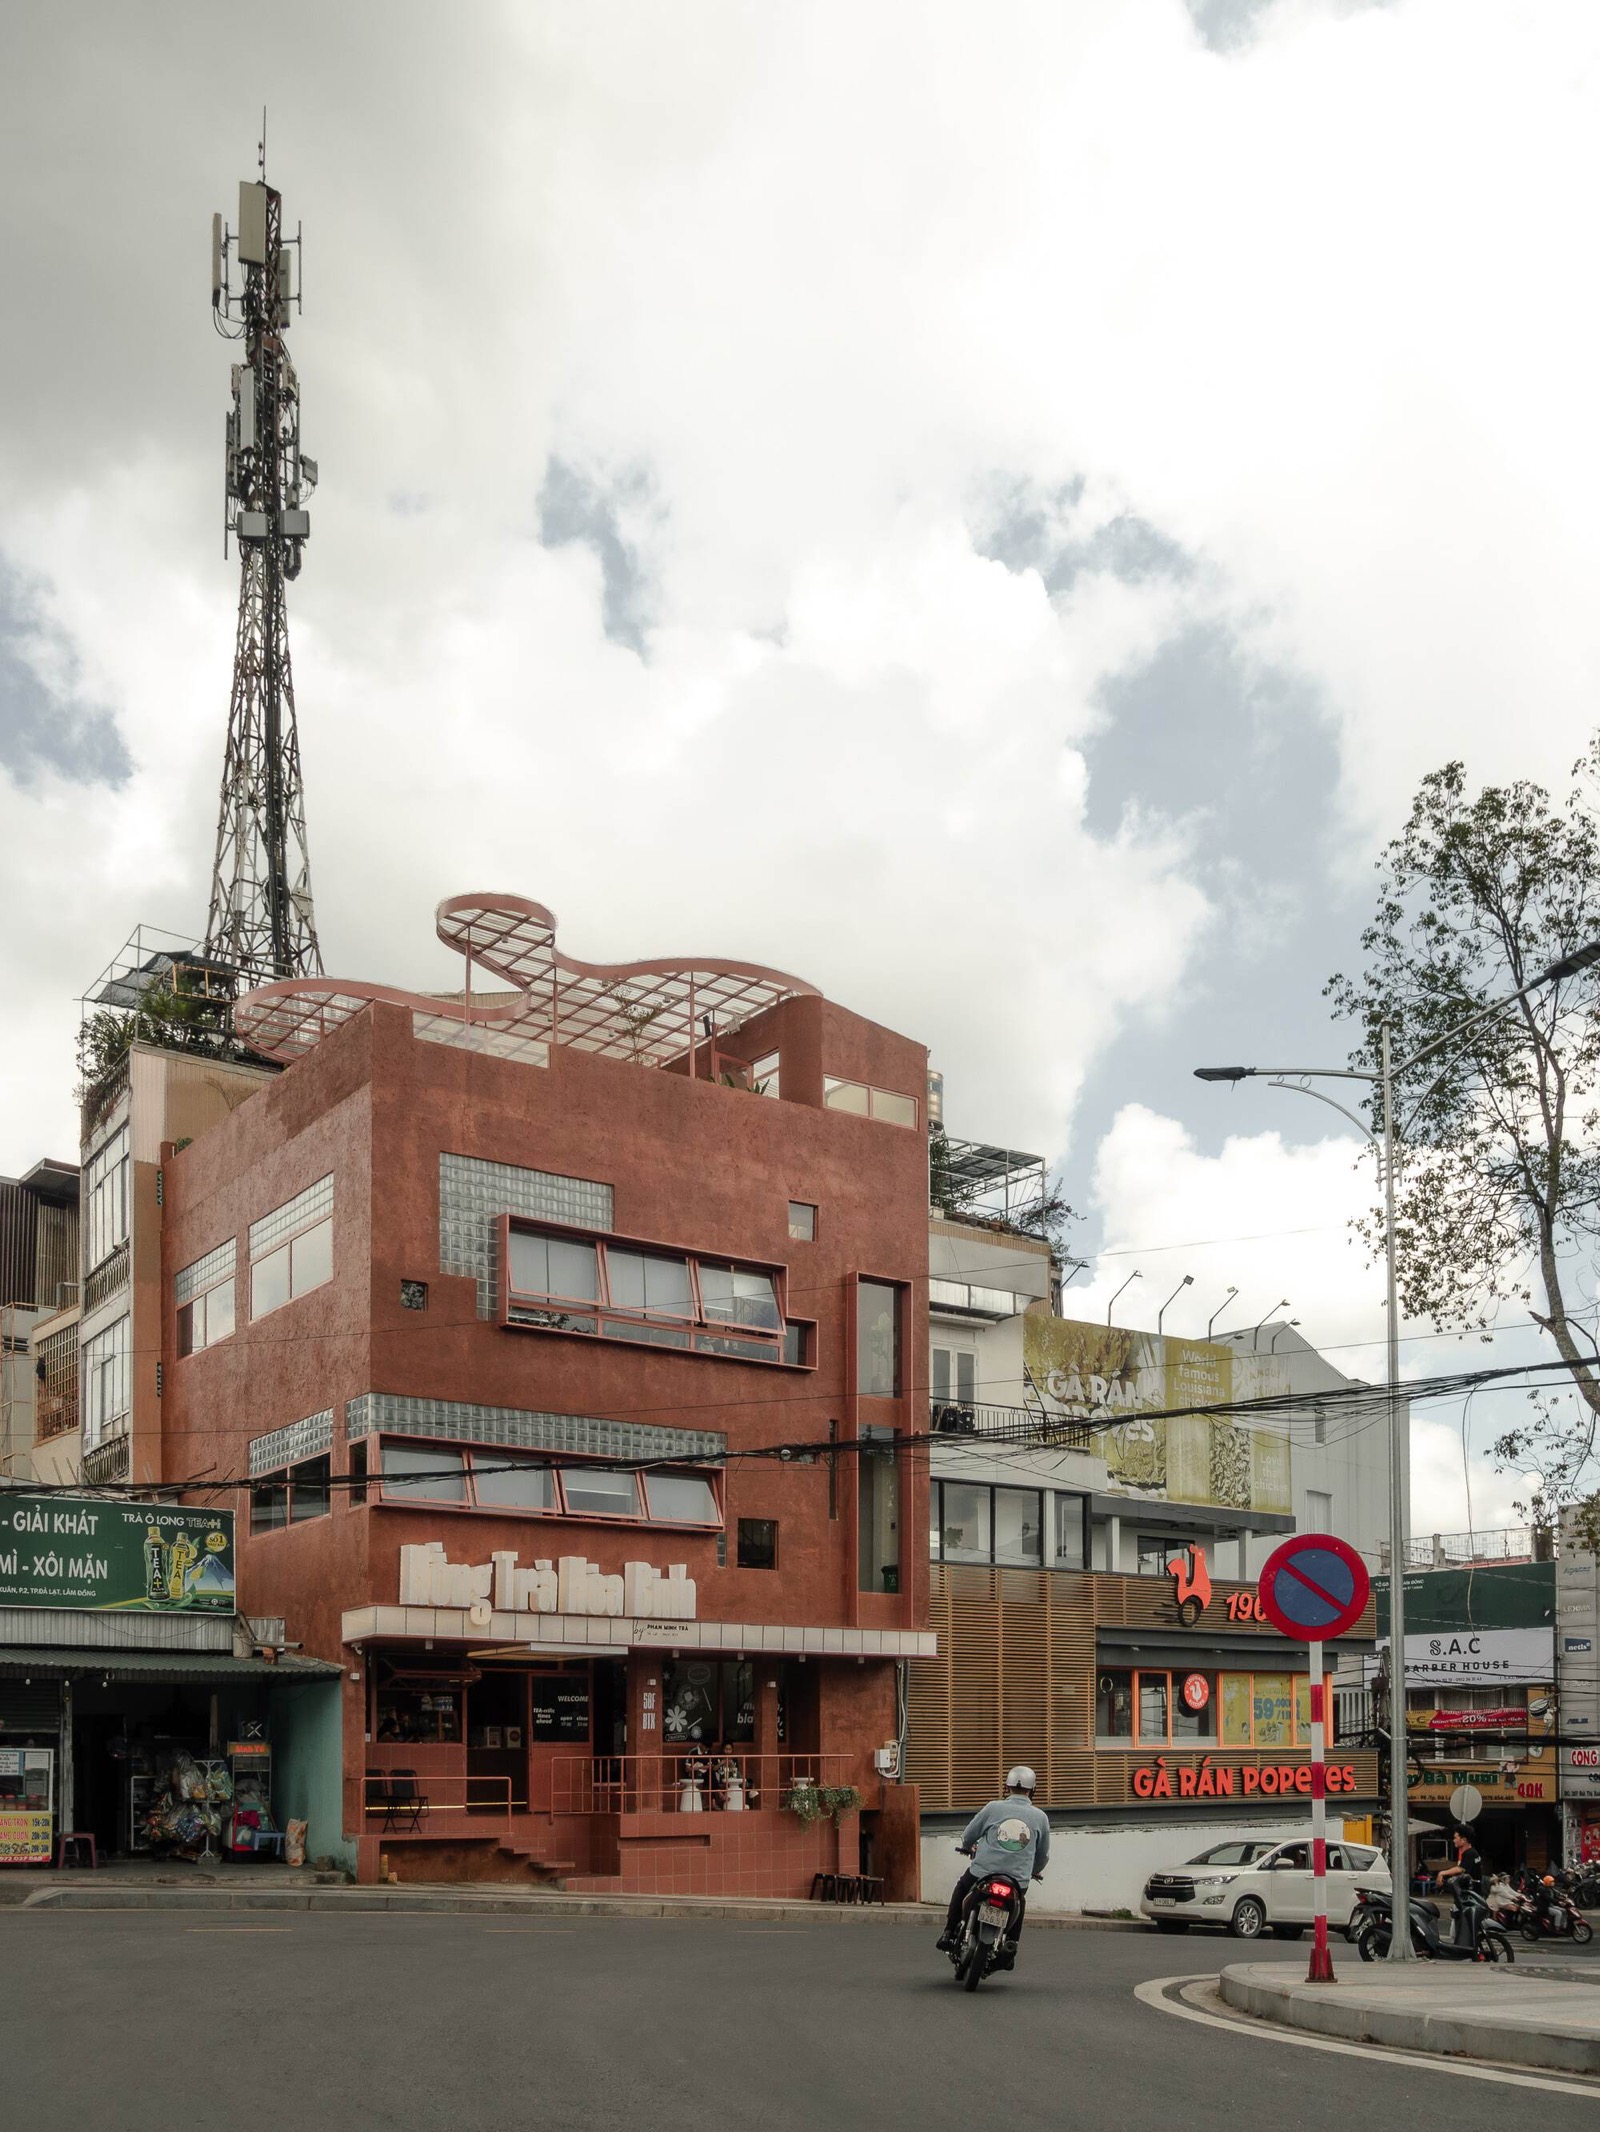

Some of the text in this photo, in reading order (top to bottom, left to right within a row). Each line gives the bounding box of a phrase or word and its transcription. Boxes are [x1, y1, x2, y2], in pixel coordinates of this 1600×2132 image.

[1182, 1349, 1216, 1368] World
[1179, 1364, 1220, 1382] famous
[1047, 1362, 1143, 1410] GÀ RÁN
[1173, 1377, 1225, 1398] Louisiana
[13, 1504, 49, 1534] GIẢI
[53, 1508, 99, 1536] KHÁT
[122, 1512, 143, 1523] TRÀ
[144, 1514, 155, 1525] Ô
[156, 1515, 185, 1527] LONG
[33, 1550, 63, 1578] XÔI
[68, 1553, 108, 1584] MẶN
[1429, 1637, 1481, 1656] S.A.C
[1462, 1660, 1510, 1672] HOUSE
[1462, 1714, 1487, 1723] 20%
[1133, 1757, 1173, 1797] GÀ
[1178, 1756, 1234, 1796] RÁN
[1517, 1782, 1544, 1798] 40K
